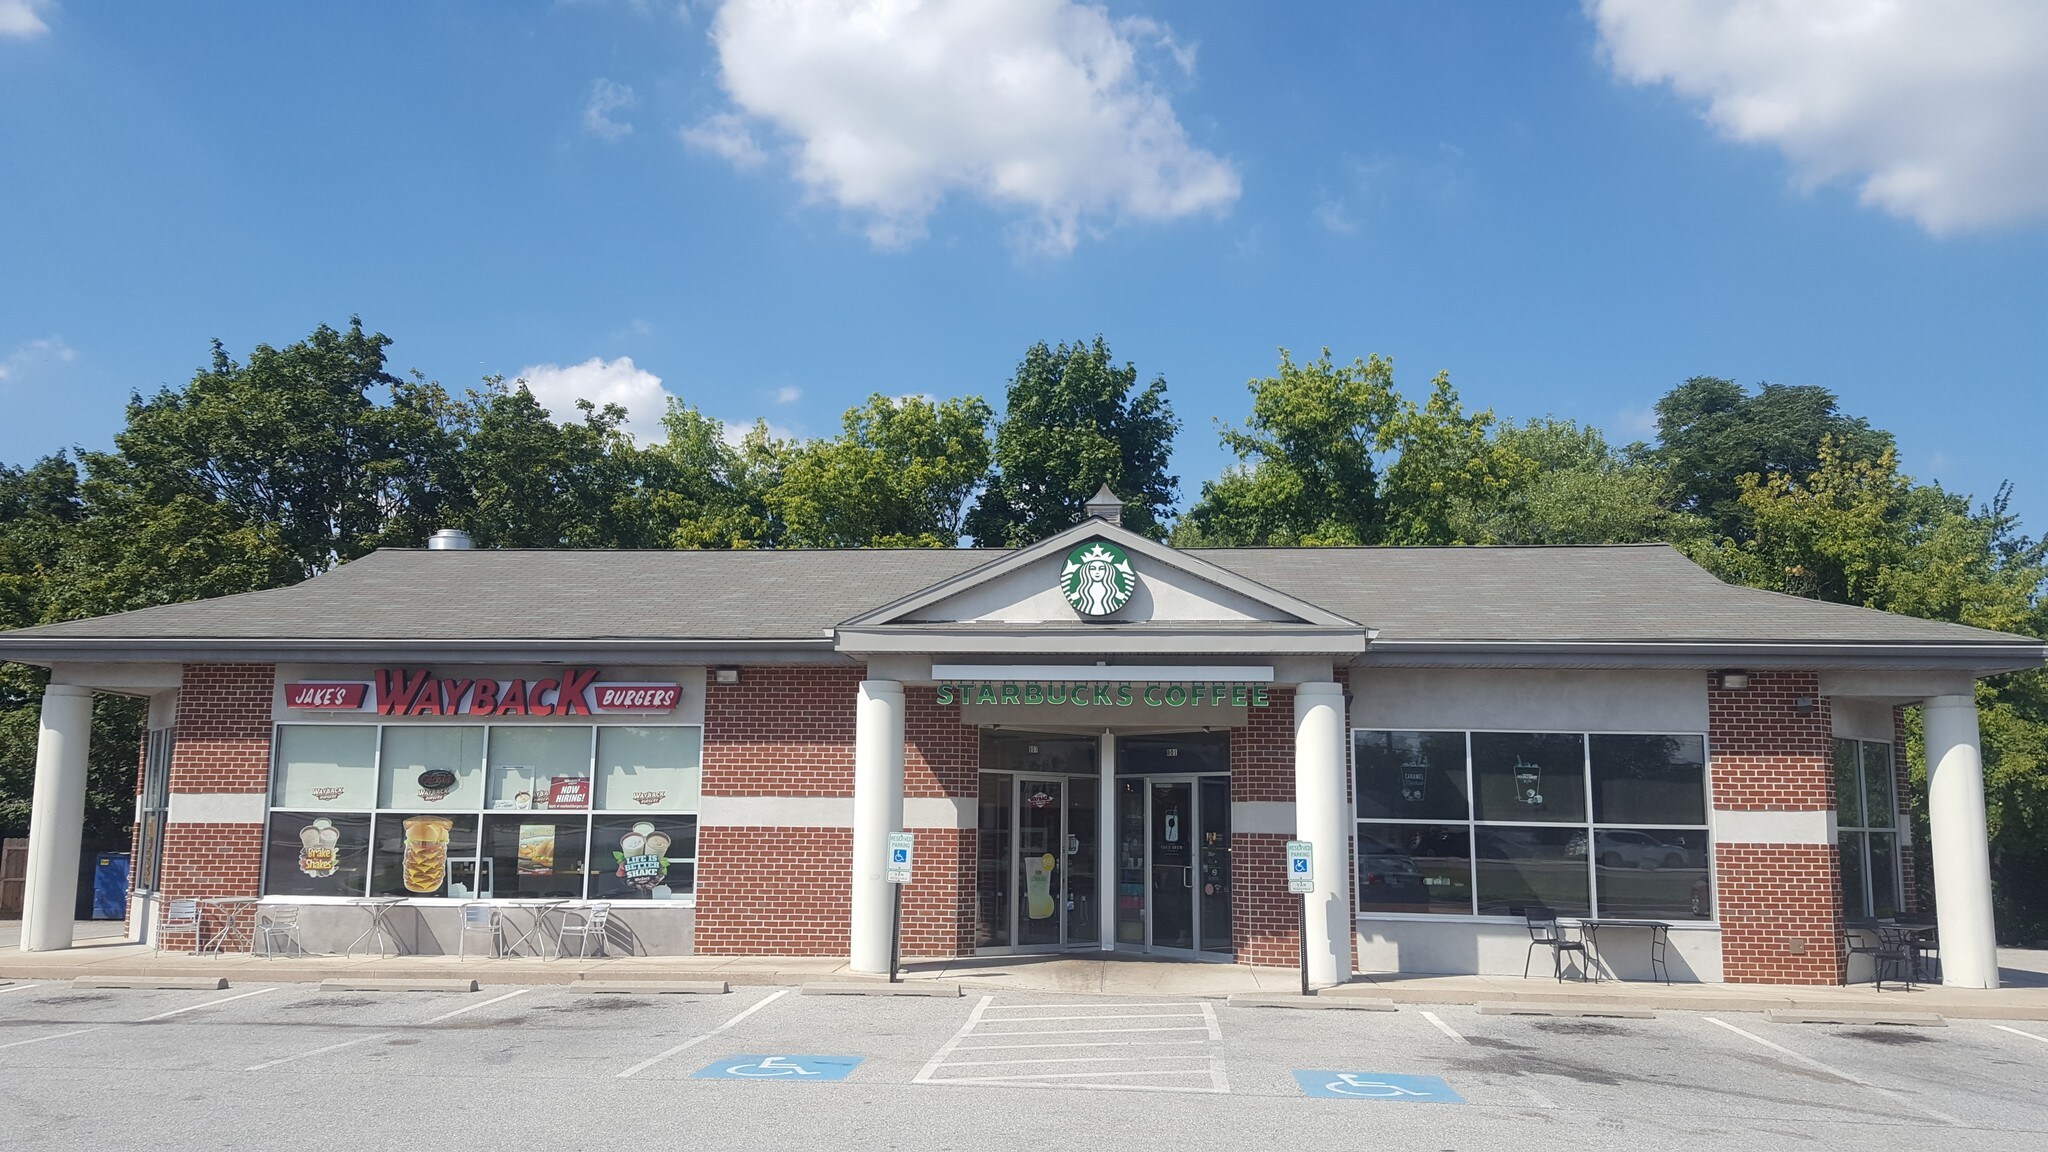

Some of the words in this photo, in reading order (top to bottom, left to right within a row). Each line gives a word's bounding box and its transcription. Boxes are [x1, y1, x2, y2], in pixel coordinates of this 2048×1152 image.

[295, 687, 346, 705] JAKE'S
[374, 668, 600, 716] WAYBACK
[936, 684, 1133, 707] STARBUCKS
[1144, 685, 1269, 707] COFFEE
[602, 690, 675, 706] BURGERS
[561, 786, 580, 794] NOW
[555, 794, 585, 803] HIRING!
[308, 847, 331, 858] Brake
[305, 859, 332, 869] Shakes
[626, 855, 647, 864] LIFE
[648, 854, 657, 862] IS
[625, 861, 659, 871] BETTER
[627, 869, 657, 878] SHAKE
